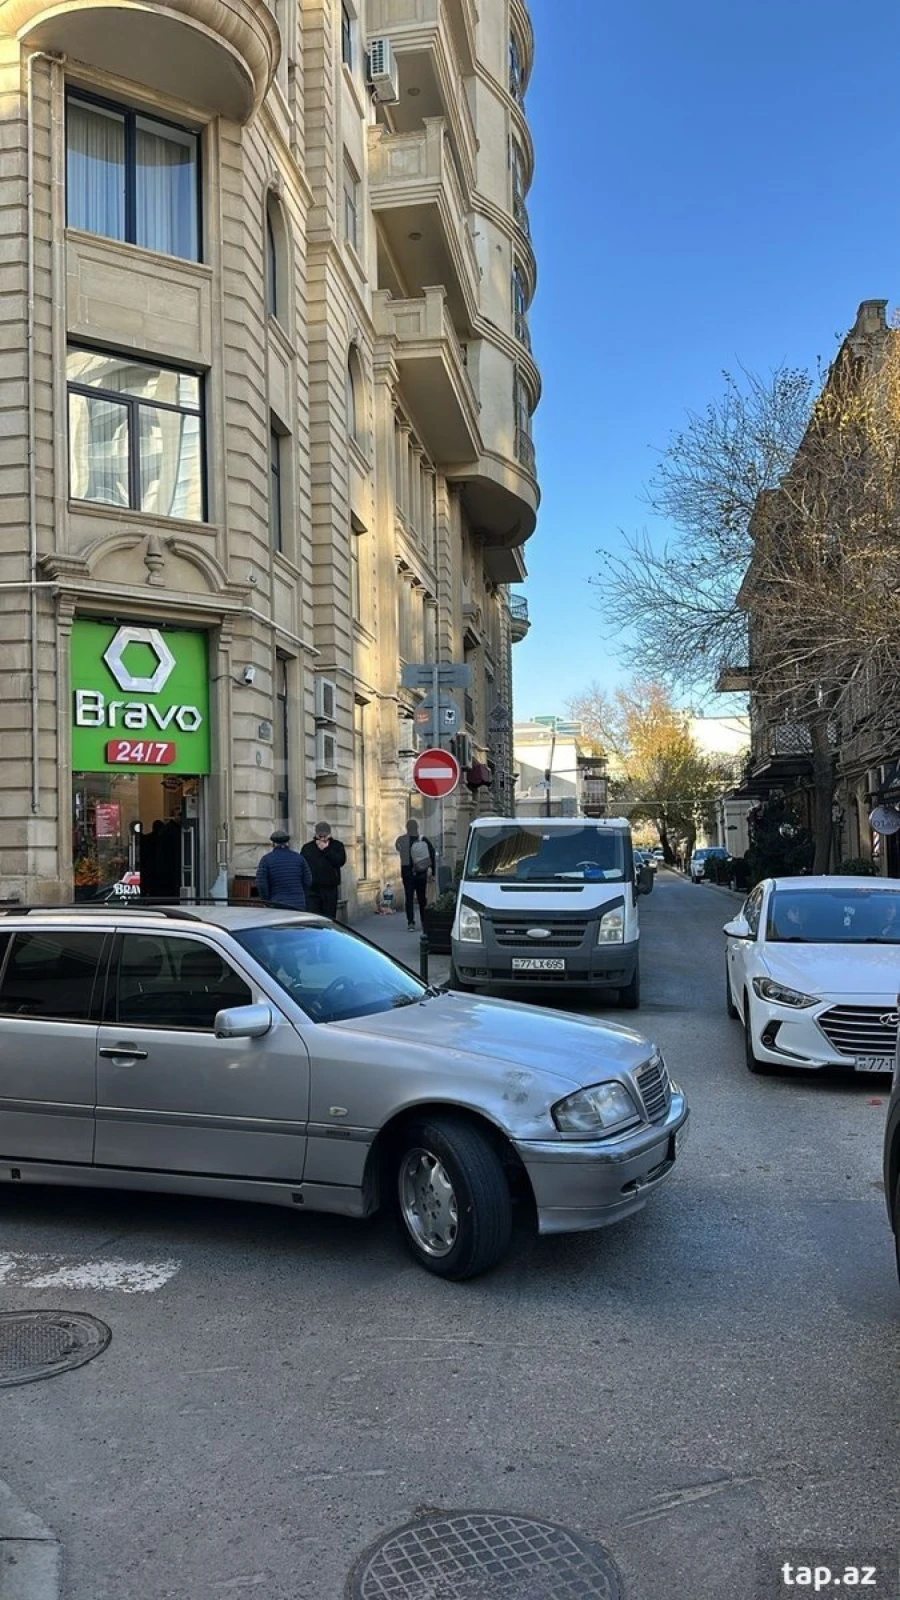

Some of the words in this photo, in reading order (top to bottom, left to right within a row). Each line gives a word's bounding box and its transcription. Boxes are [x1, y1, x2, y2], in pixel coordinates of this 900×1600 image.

[75, 689, 203, 731] Bravo
[116, 741, 168, 763] 24/7
[520, 959, 563, 969] 77-LX-695
